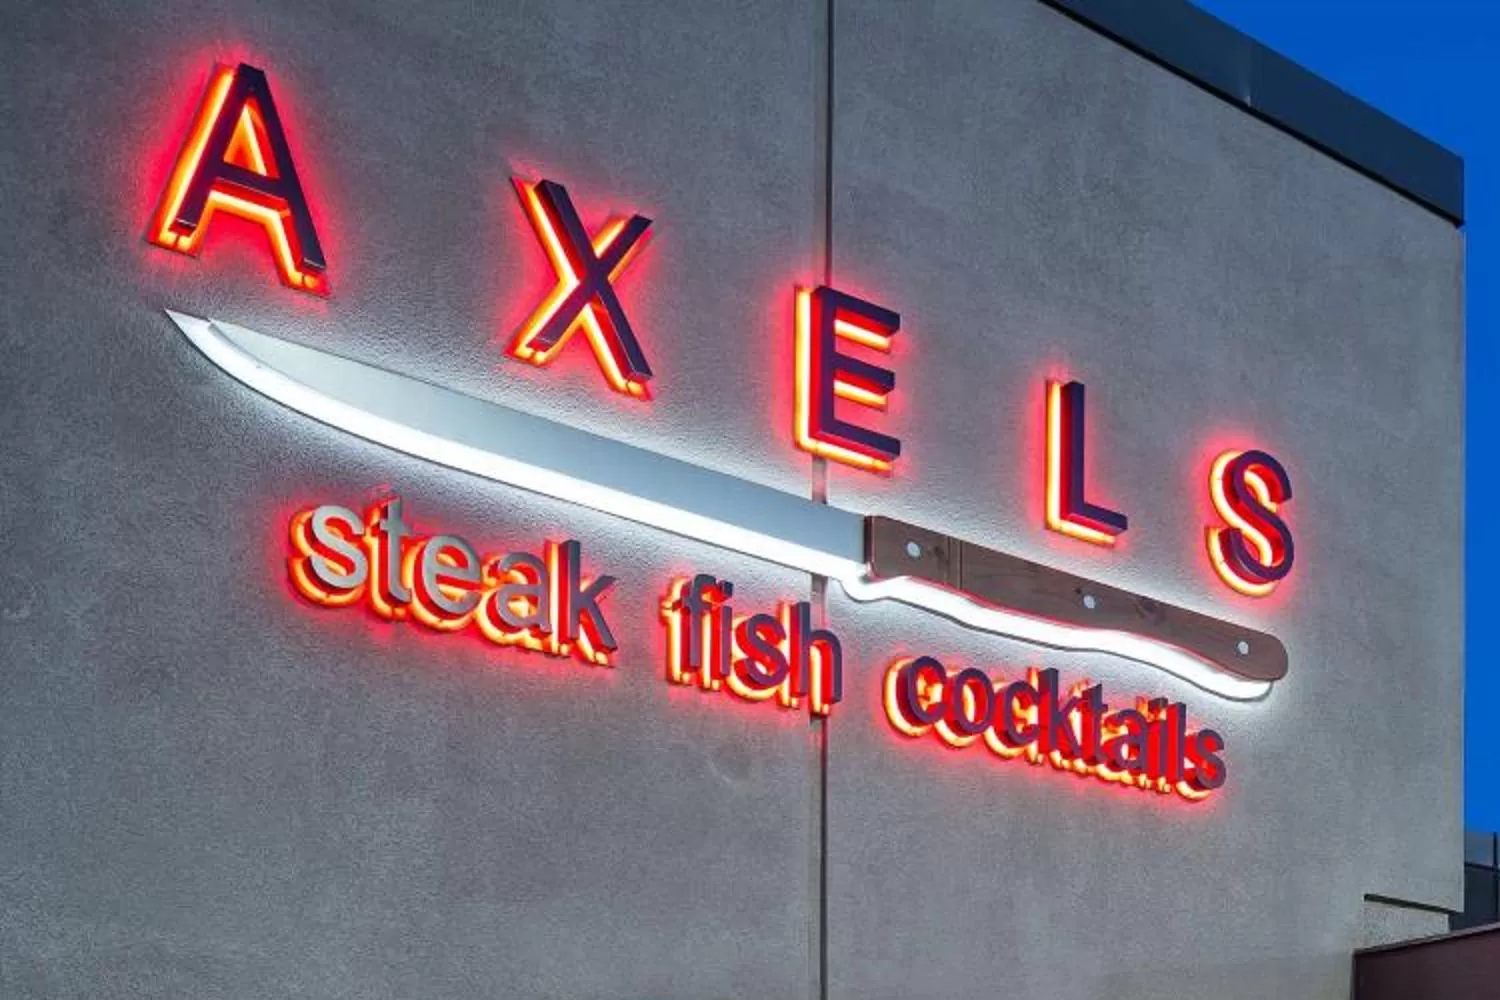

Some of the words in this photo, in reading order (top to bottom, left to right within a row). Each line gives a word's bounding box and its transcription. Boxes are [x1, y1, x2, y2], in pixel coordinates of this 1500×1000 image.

[152, 63, 1294, 595] AXELS
[290, 496, 618, 666] steak
[664, 574, 843, 713] fish
[884, 655, 1227, 799] cocktails
